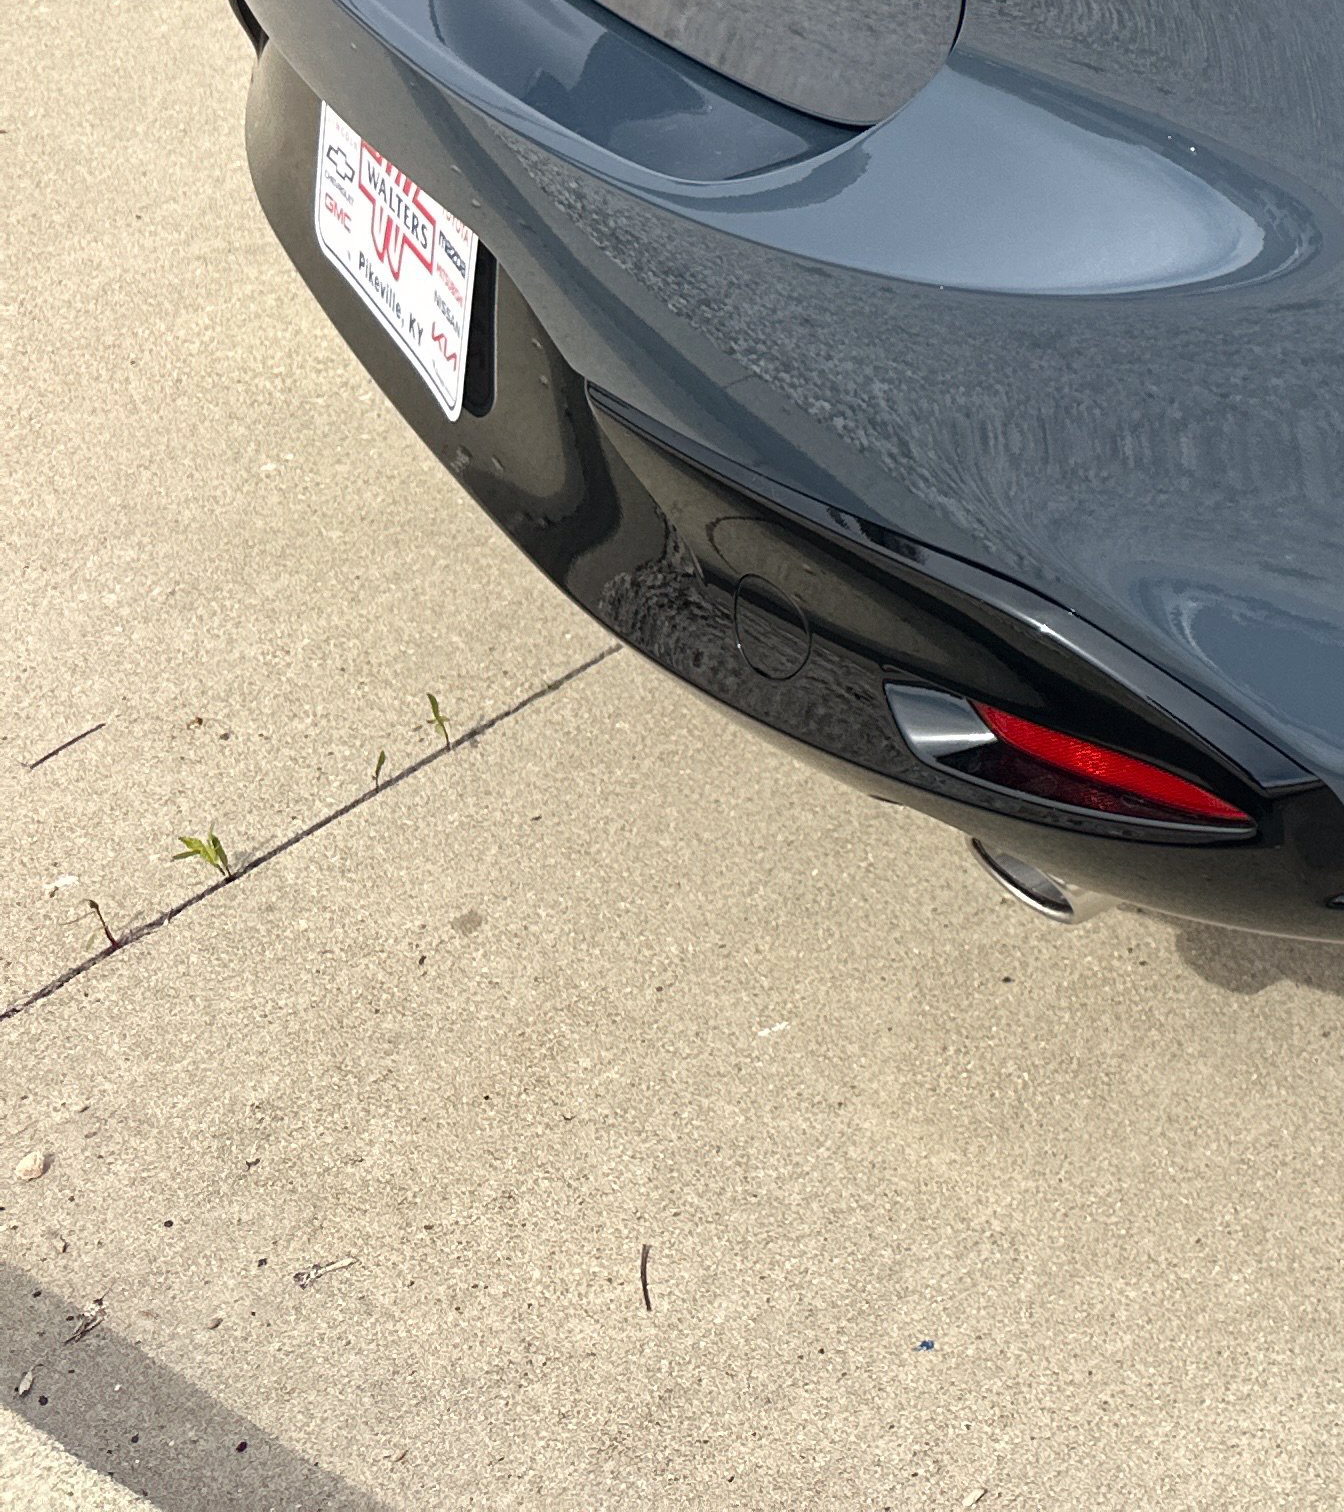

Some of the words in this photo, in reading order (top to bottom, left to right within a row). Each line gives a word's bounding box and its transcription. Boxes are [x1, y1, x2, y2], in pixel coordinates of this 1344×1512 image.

[324, 192, 352, 234] GMC
[367, 159, 428, 250] WALTERS
[358, 250, 405, 329] Pikeville,
[409, 312, 424, 347] KY
[434, 289, 460, 338] NISSAN
